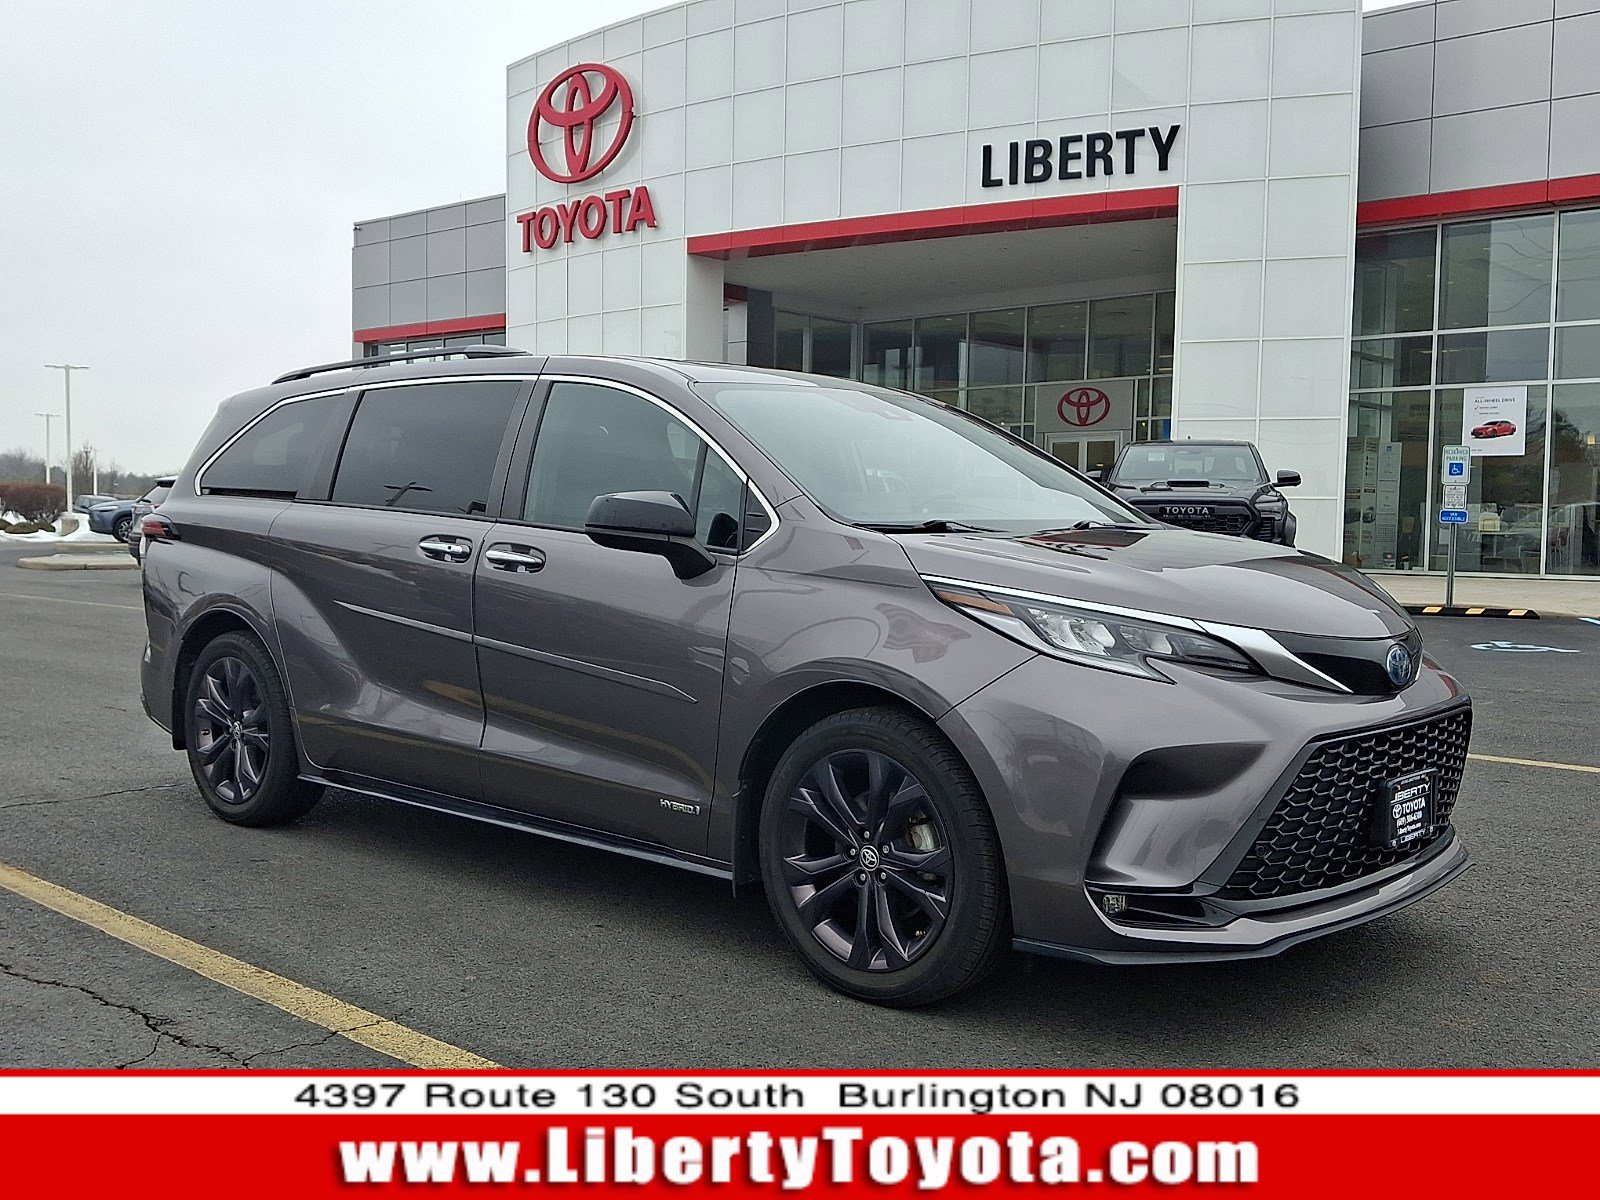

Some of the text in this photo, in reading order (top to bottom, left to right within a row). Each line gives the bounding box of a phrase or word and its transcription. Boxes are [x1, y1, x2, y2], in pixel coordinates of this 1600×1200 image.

[981, 124, 1181, 188] LIBERTY
[516, 186, 657, 253] TOYOTA
[1165, 506, 1209, 514] TOYOTA
[1391, 782, 1430, 804] LIBERTY
[1402, 797, 1426, 815] TOYOTA
